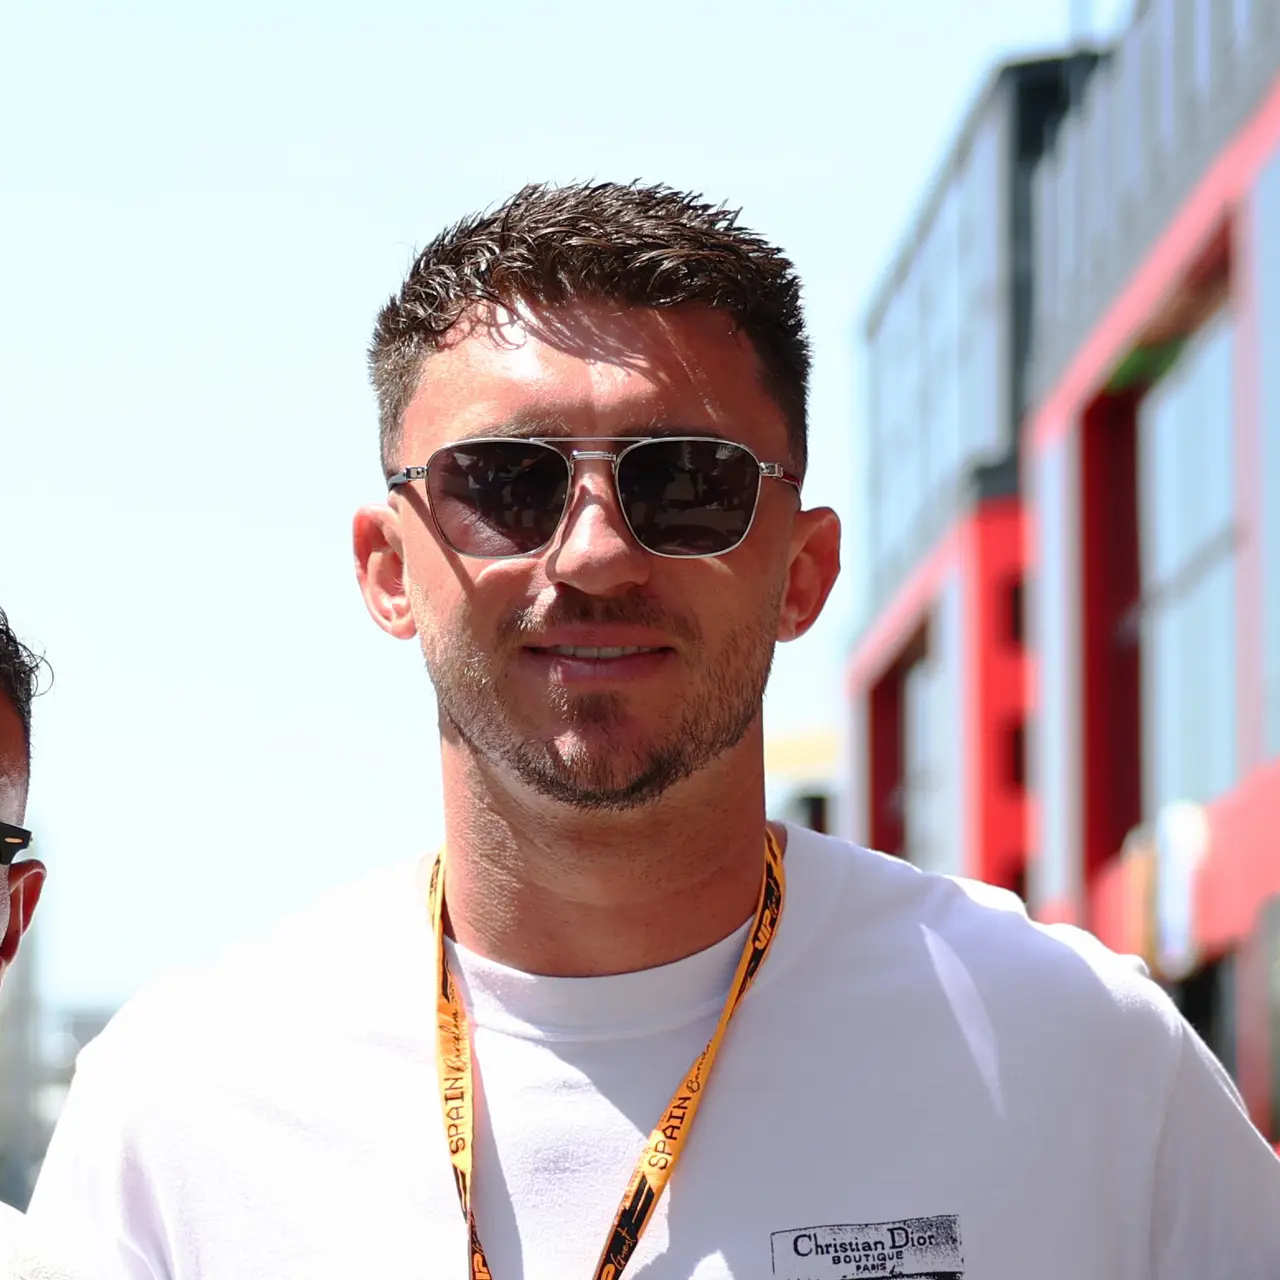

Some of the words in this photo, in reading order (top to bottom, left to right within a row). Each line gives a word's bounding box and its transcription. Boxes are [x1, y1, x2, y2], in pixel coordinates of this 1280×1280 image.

[444, 1076, 466, 1157] SPAIN
[648, 1096, 692, 1171] SPAIN
[793, 1233, 885, 1257] Christian
[887, 1226, 935, 1250] Dior
[832, 1250, 904, 1265] BOUTIQUE
[855, 1263, 887, 1272] PARIS
